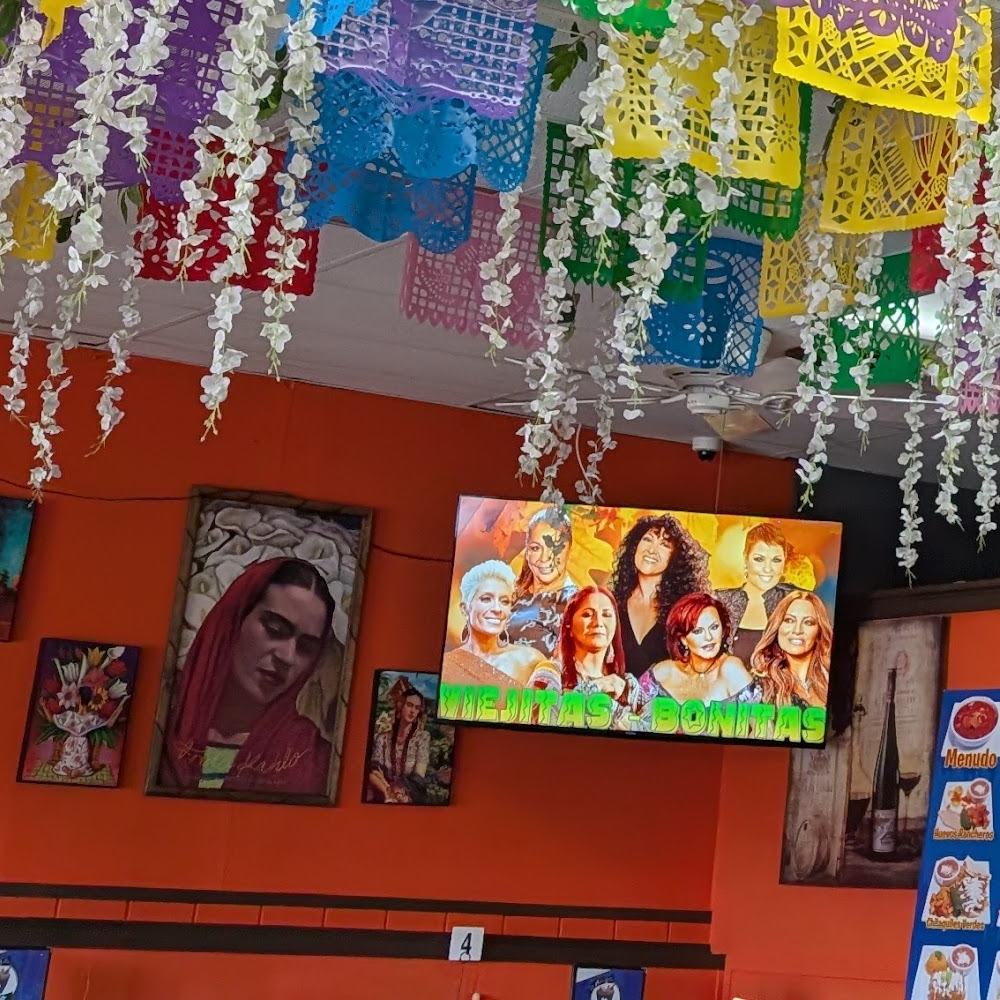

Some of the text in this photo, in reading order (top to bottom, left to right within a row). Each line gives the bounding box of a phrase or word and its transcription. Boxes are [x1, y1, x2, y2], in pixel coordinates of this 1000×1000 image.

[439, 682, 614, 730] VIEJITAS
[651, 696, 827, 744] BONITAS
[944, 749, 998, 768] Menudo
[460, 932, 472, 955] 4
